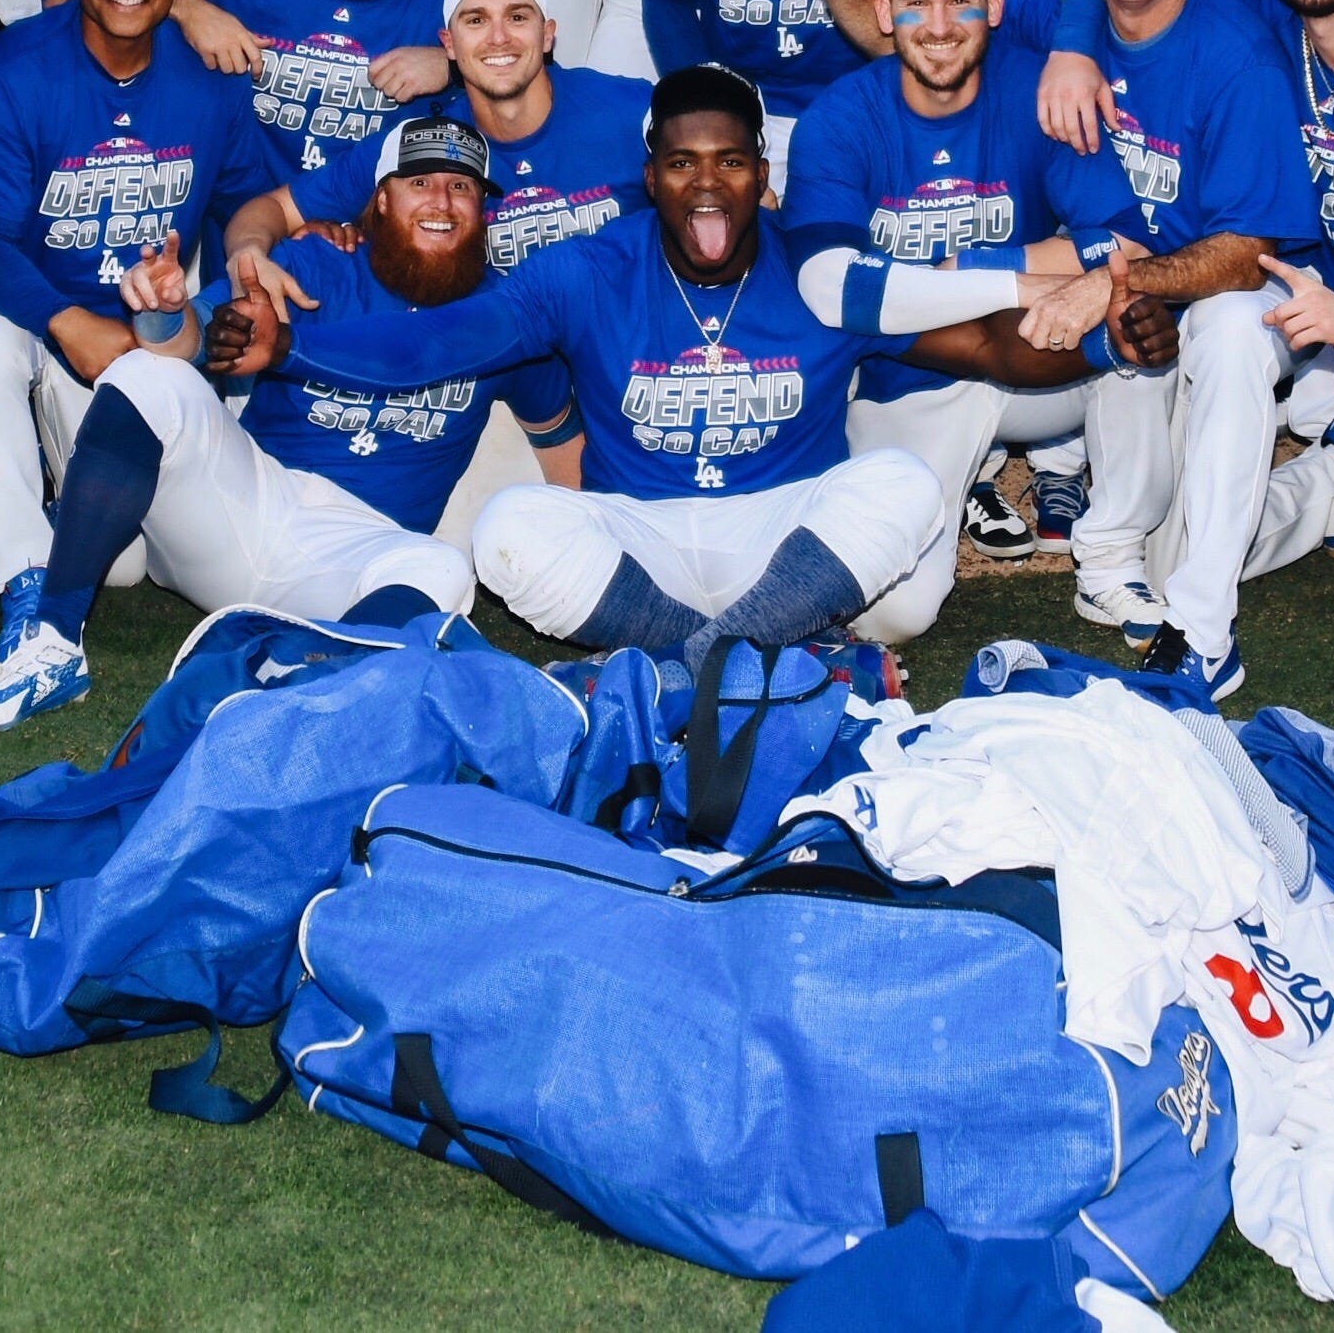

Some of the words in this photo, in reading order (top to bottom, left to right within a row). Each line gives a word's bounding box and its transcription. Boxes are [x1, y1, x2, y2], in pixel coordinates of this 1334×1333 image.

[295, 44, 370, 66] CHAMPIONS
[776, 26, 804, 59] LA
[252, 92, 306, 132] SO
[84, 152, 155, 167] CHAMPIONS
[300, 135, 327, 171] LA
[38, 158, 194, 218] DEFEND
[907, 193, 979, 209] CHAMPION
[496, 197, 568, 221] CHAMPIONS
[44, 218, 101, 251] SO
[103, 212, 176, 248] CAL
[486, 197, 621, 269] EFEND
[97, 249, 124, 285] LA
[307, 398, 380, 433] SO
[620, 370, 805, 429] DEFEND
[631, 422, 694, 454] SO
[693, 455, 726, 490] LA
